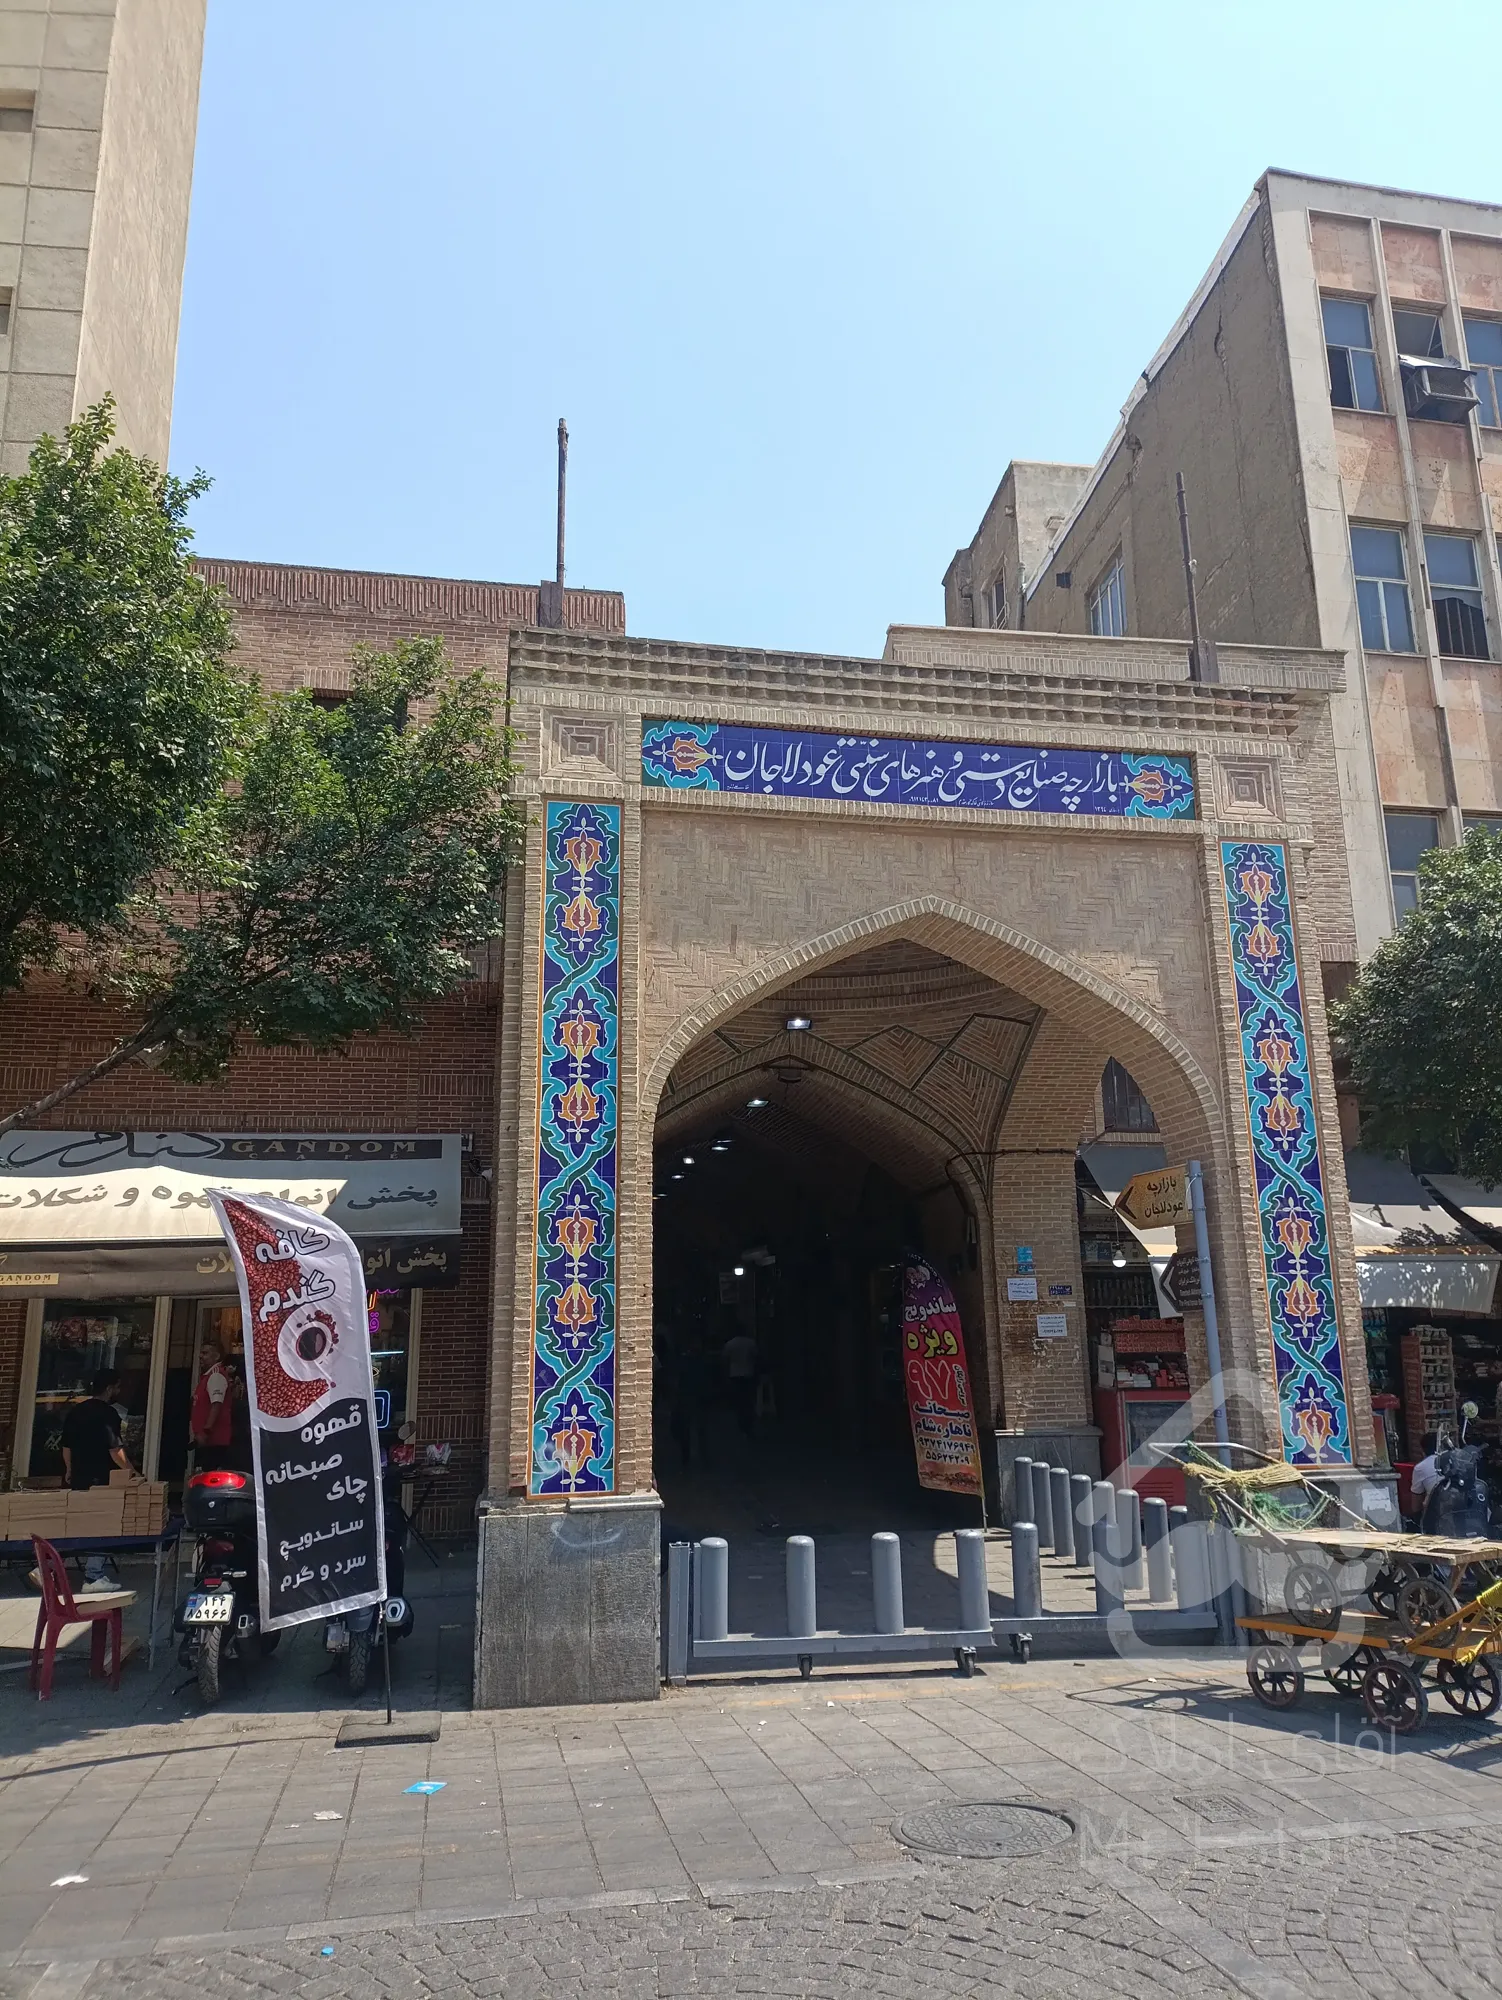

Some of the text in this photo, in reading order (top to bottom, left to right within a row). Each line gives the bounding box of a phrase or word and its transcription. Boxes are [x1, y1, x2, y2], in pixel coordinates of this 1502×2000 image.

[724, 741, 843, 794] عودلاجان
[948, 750, 964, 770] و
[937, 752, 1036, 802] دستی
[1007, 749, 1068, 809] صنایع
[1059, 752, 1118, 812] بازارچه
[231, 1140, 416, 1153] GANDOM
[0, 1184, 108, 1208] شکلات
[114, 1187, 139, 1207] و
[346, 1186, 438, 1210] پخش
[1146, 1175, 1177, 1197] بازارچه
[1144, 1200, 1184, 1218] عودلاجان
[255, 1226, 331, 1264] کافه
[396, 1246, 448, 1273] پخش
[259, 1268, 336, 1322] گندم
[904, 1296, 957, 1321] ساندویچ
[906, 1323, 958, 1358] ویژه
[907, 1359, 951, 1400] ۹۷
[301, 1403, 362, 1445] قهوه
[914, 1400, 971, 1420] صبحانه
[265, 1453, 343, 1485] صبحانه
[326, 1475, 368, 1504] چای
[280, 1519, 364, 1561] ساندویچ
[280, 1555, 367, 1592] سرد و گرم
[187, 1608, 228, 1620] ۸۵۹۶۶
[204, 1596, 226, 1606] ۱۴۴
